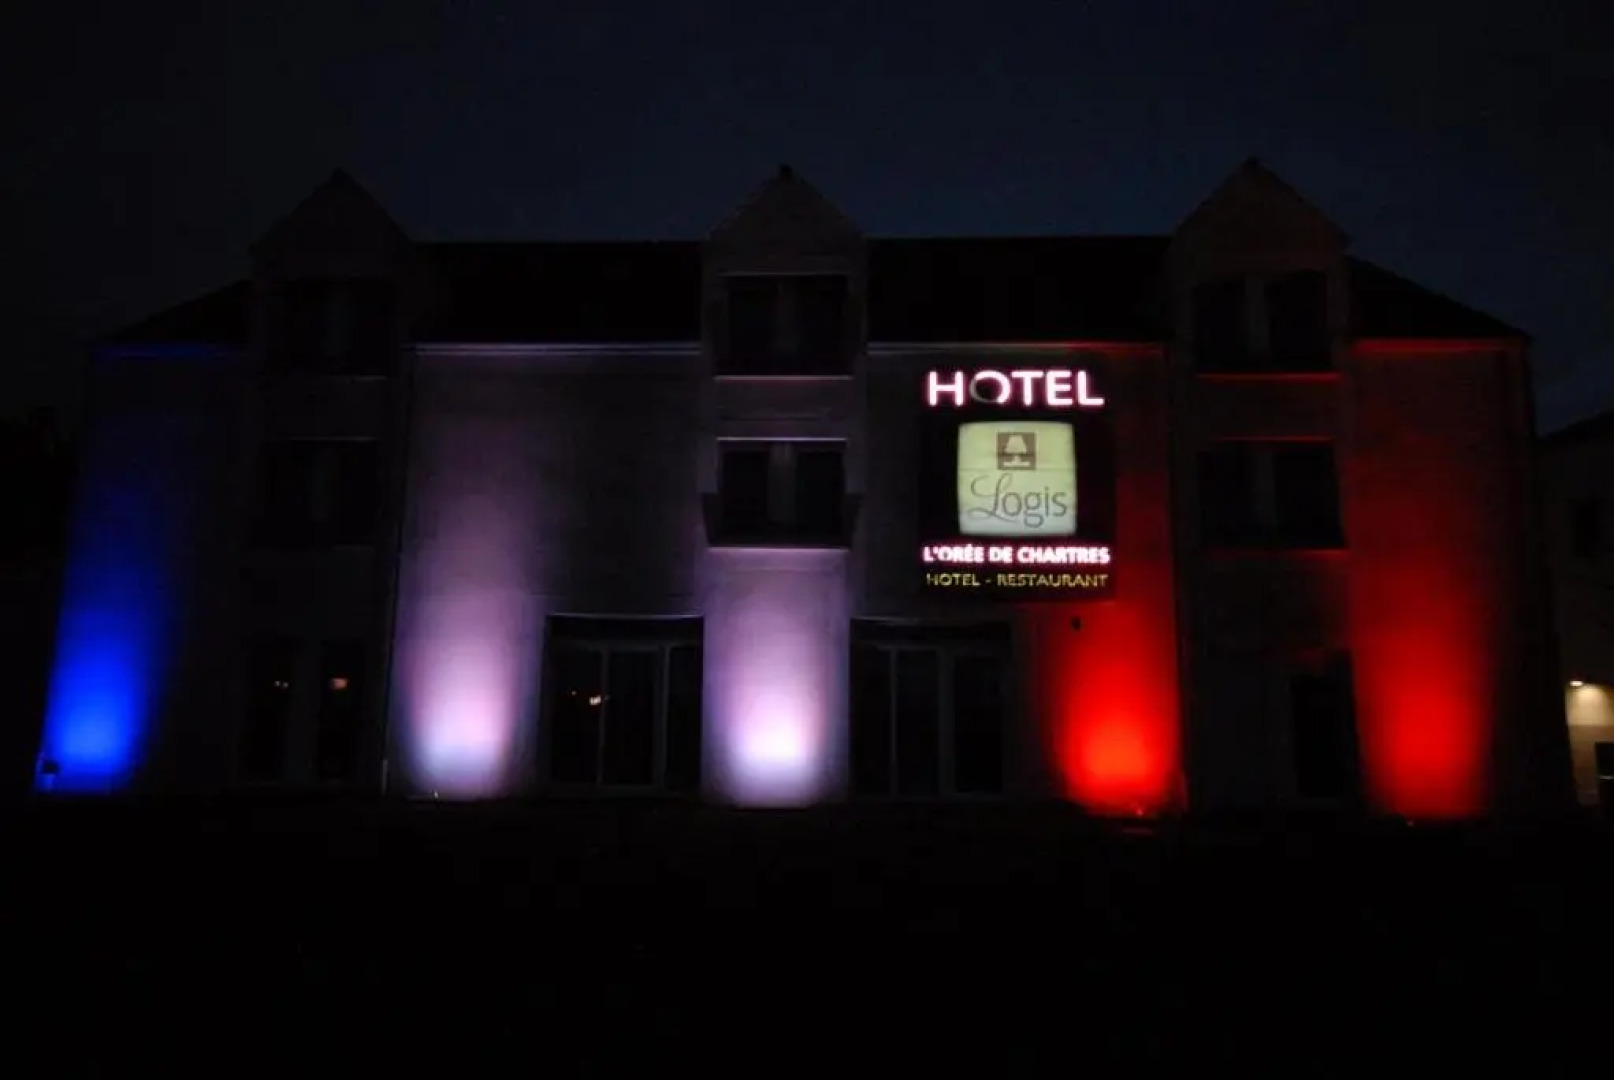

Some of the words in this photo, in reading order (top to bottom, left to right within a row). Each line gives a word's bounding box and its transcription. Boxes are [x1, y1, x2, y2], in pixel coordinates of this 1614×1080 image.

[927, 370, 1105, 407] HOTEL
[967, 472, 1068, 529] Logis
[989, 546, 1013, 564] DE
[1016, 546, 1111, 565] CHARTRES
[926, 573, 981, 587] HOTEL
[997, 573, 1109, 588] RESTAURANT
